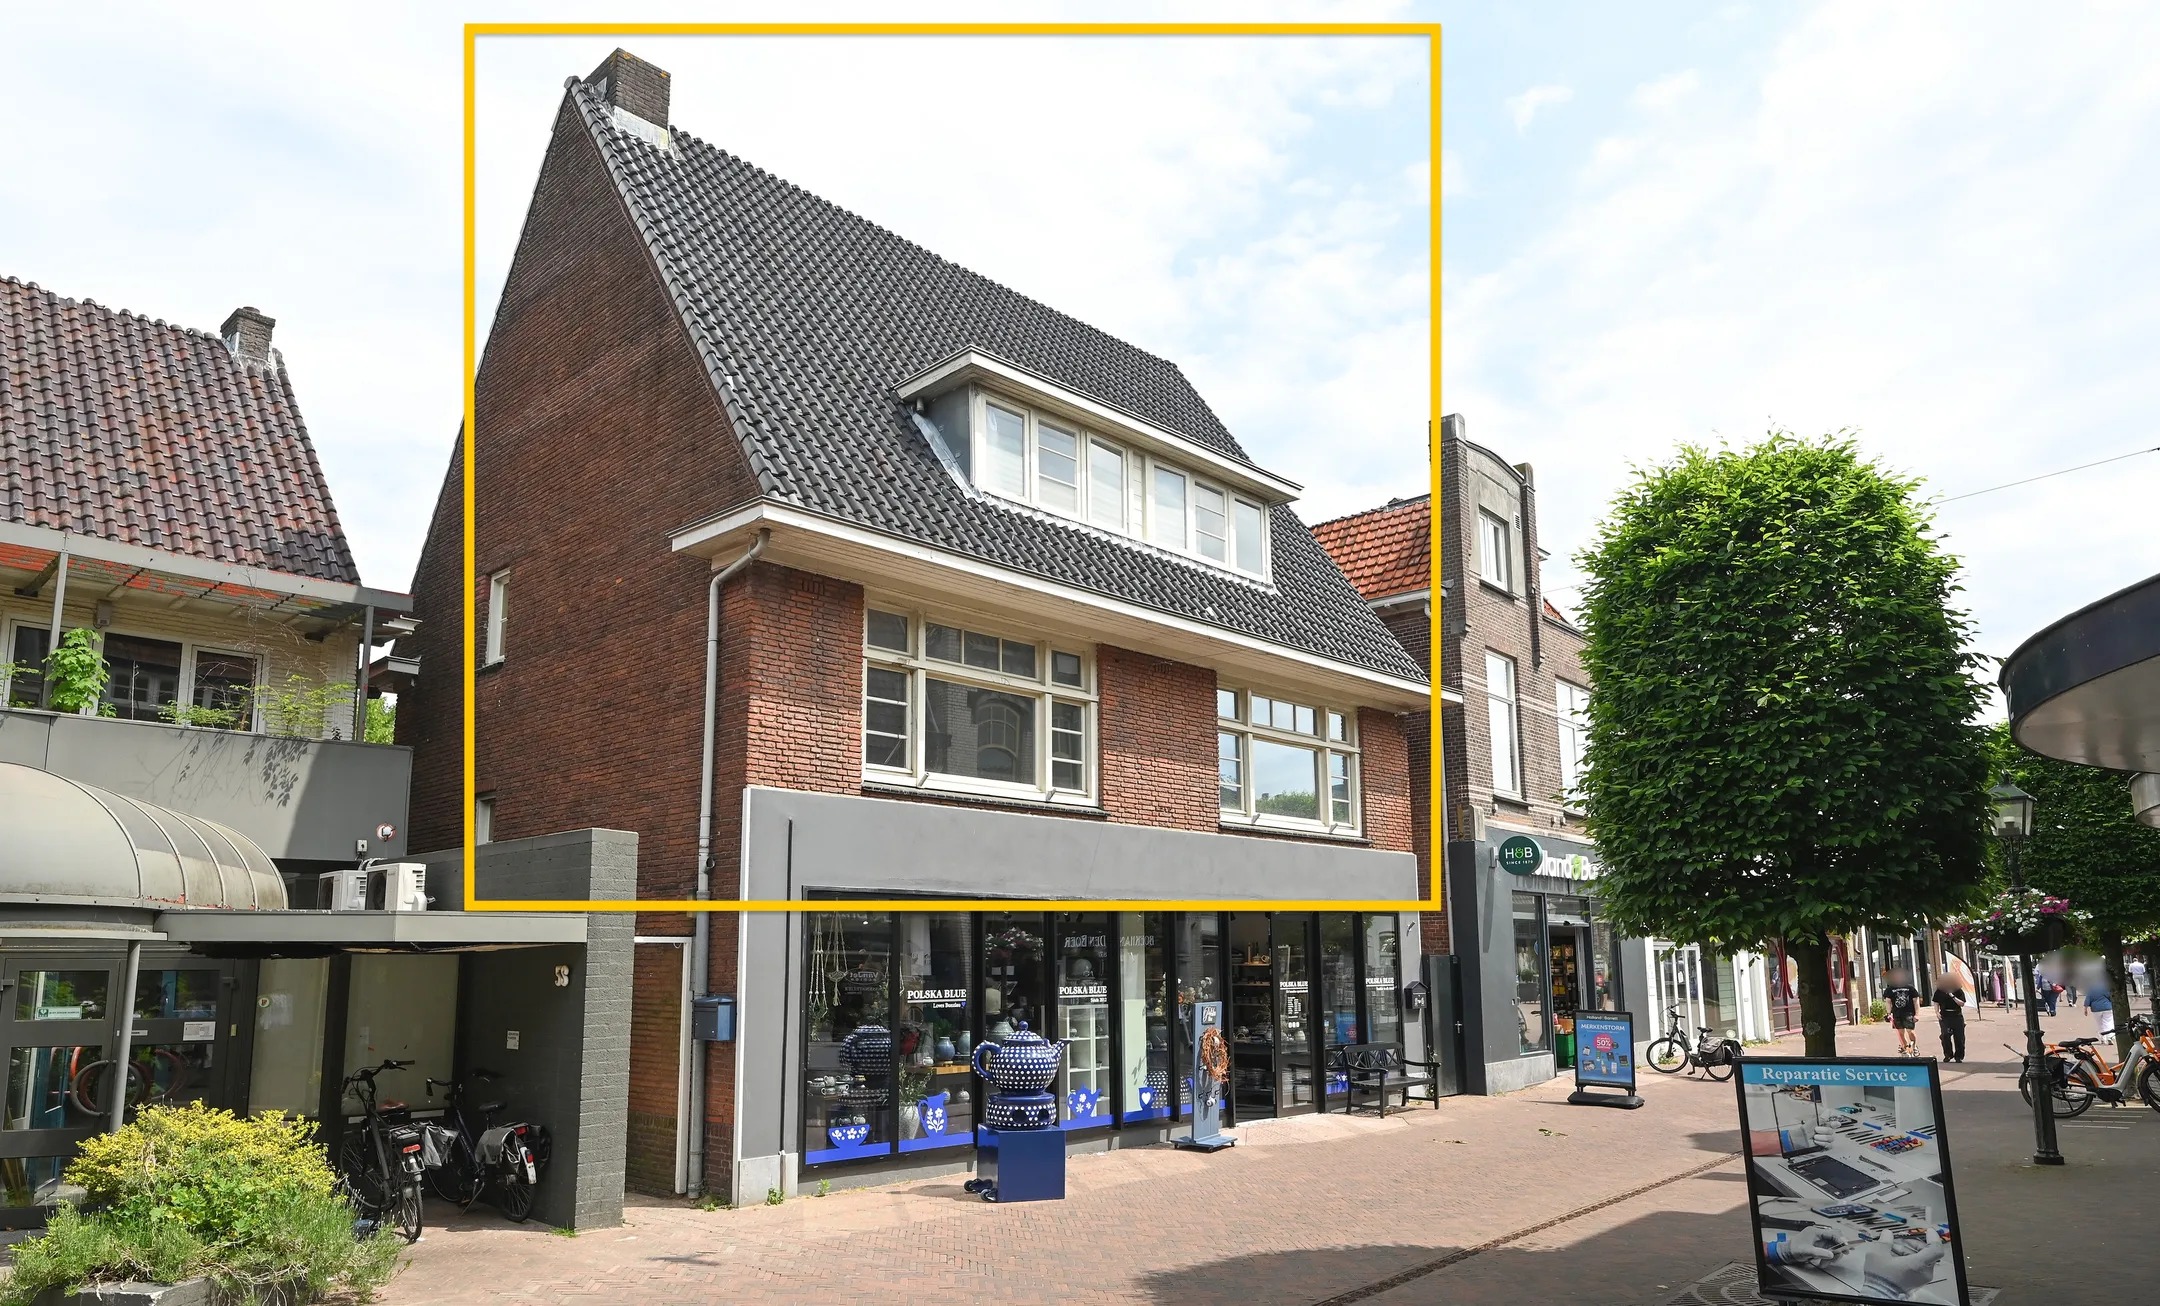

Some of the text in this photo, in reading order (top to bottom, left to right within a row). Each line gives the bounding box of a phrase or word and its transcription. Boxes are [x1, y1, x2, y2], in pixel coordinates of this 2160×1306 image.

[1504, 847, 1533, 859] H&B
[907, 988, 967, 1000] POLSKA BLUE
[1059, 985, 1108, 995] POLSKA BLUE
[1580, 1023, 1626, 1031] MERKENSTORM
[1596, 1039, 1611, 1047] 50%
[1762, 1067, 1908, 1083] Reparatie Service
